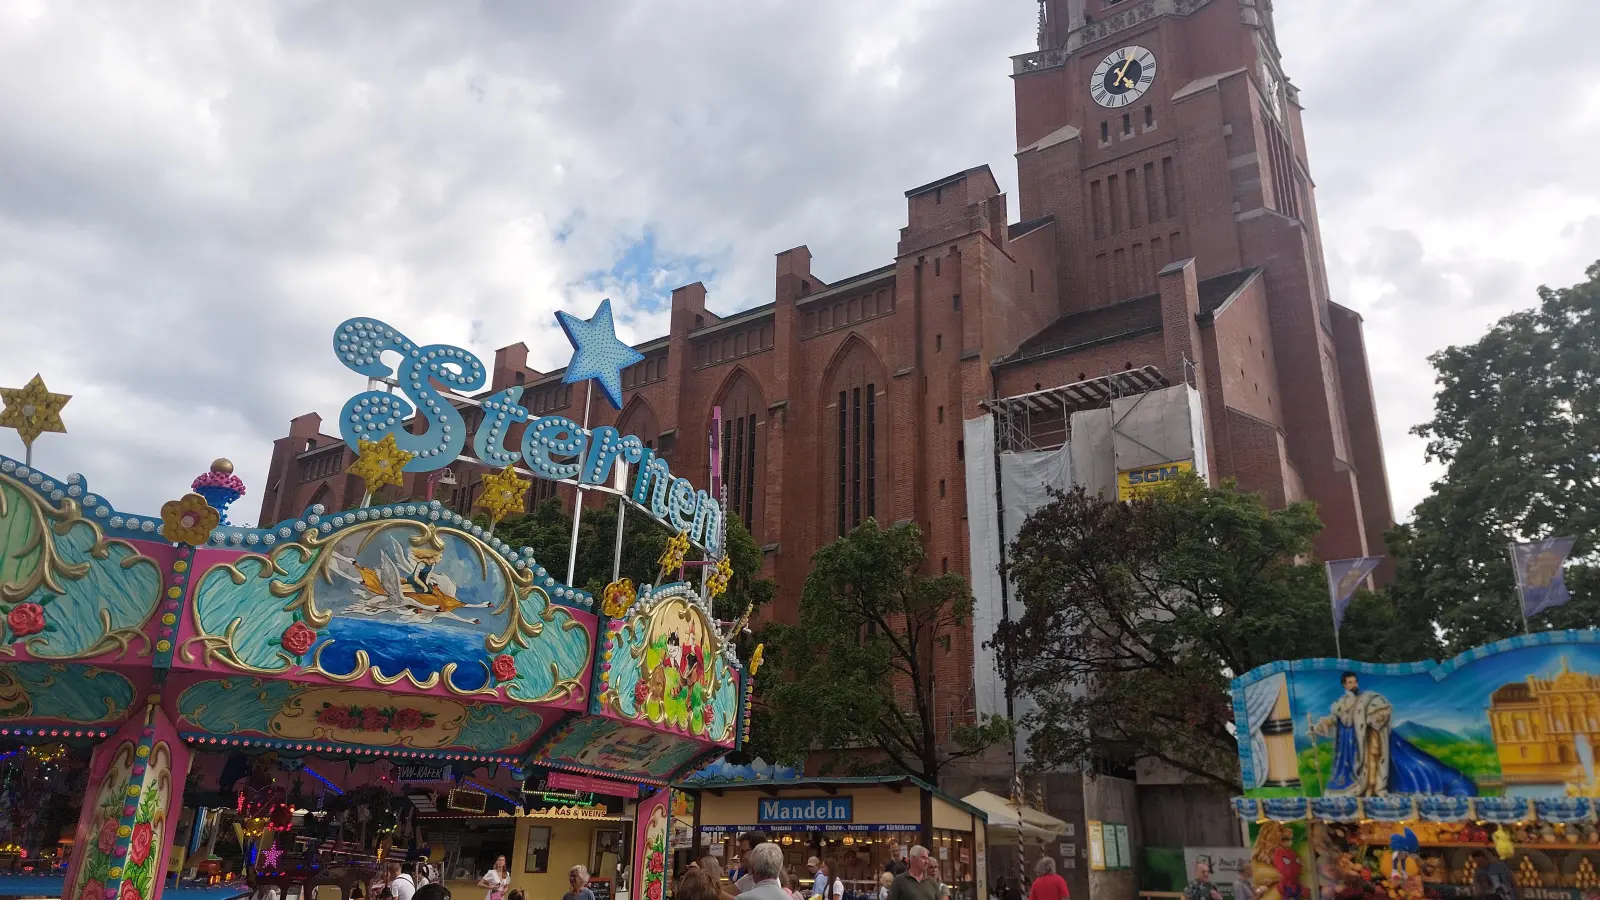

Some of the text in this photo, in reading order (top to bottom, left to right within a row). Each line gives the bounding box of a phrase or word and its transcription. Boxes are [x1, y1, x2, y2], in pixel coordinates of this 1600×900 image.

[333, 316, 721, 553] Sternen
[1129, 465, 1178, 484] SGM
[763, 800, 846, 820] Mandeln
